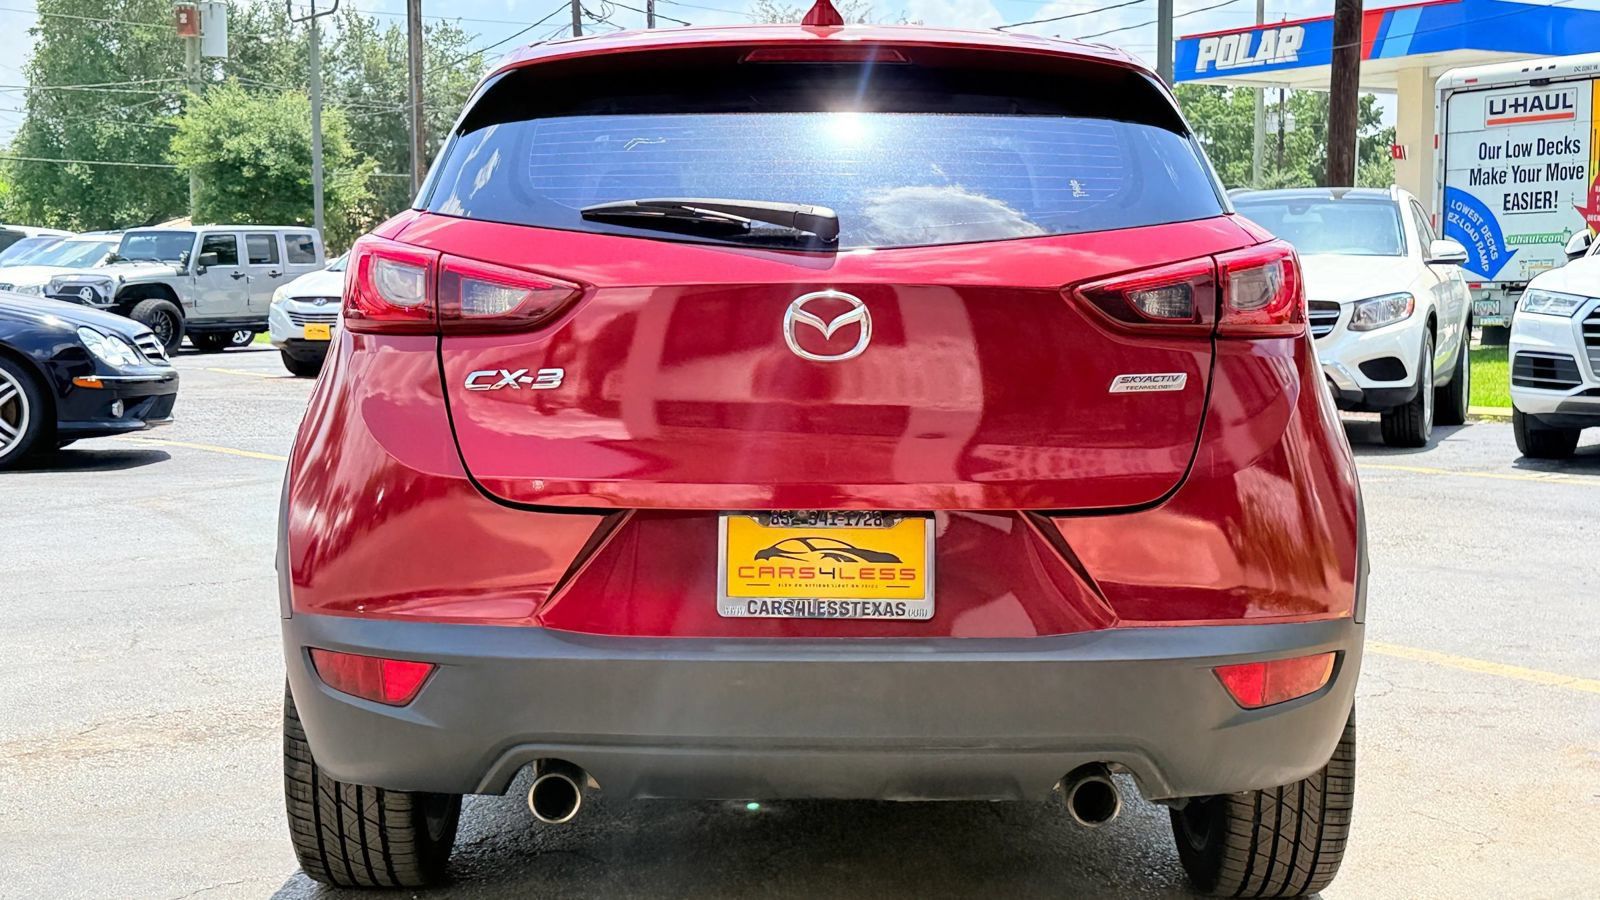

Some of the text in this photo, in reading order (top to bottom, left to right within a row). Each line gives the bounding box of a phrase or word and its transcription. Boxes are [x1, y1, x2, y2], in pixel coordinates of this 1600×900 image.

[1195, 26, 1305, 73] POLAR
[1489, 92, 1574, 115] U-HAUL
[1478, 135, 1581, 160] Our Low Decks
[1469, 163, 1584, 186] Make Your Move
[1503, 190, 1558, 211] EASIER!
[1450, 199, 1499, 260] LOWEST DECKS
[1447, 211, 1480, 242] EZ-LOAD
[1475, 240, 1490, 272] RAMP
[464, 368, 564, 391] CX-3
[1119, 375, 1181, 384] SKYACTIV
[738, 566, 916, 581] CARS4LESS
